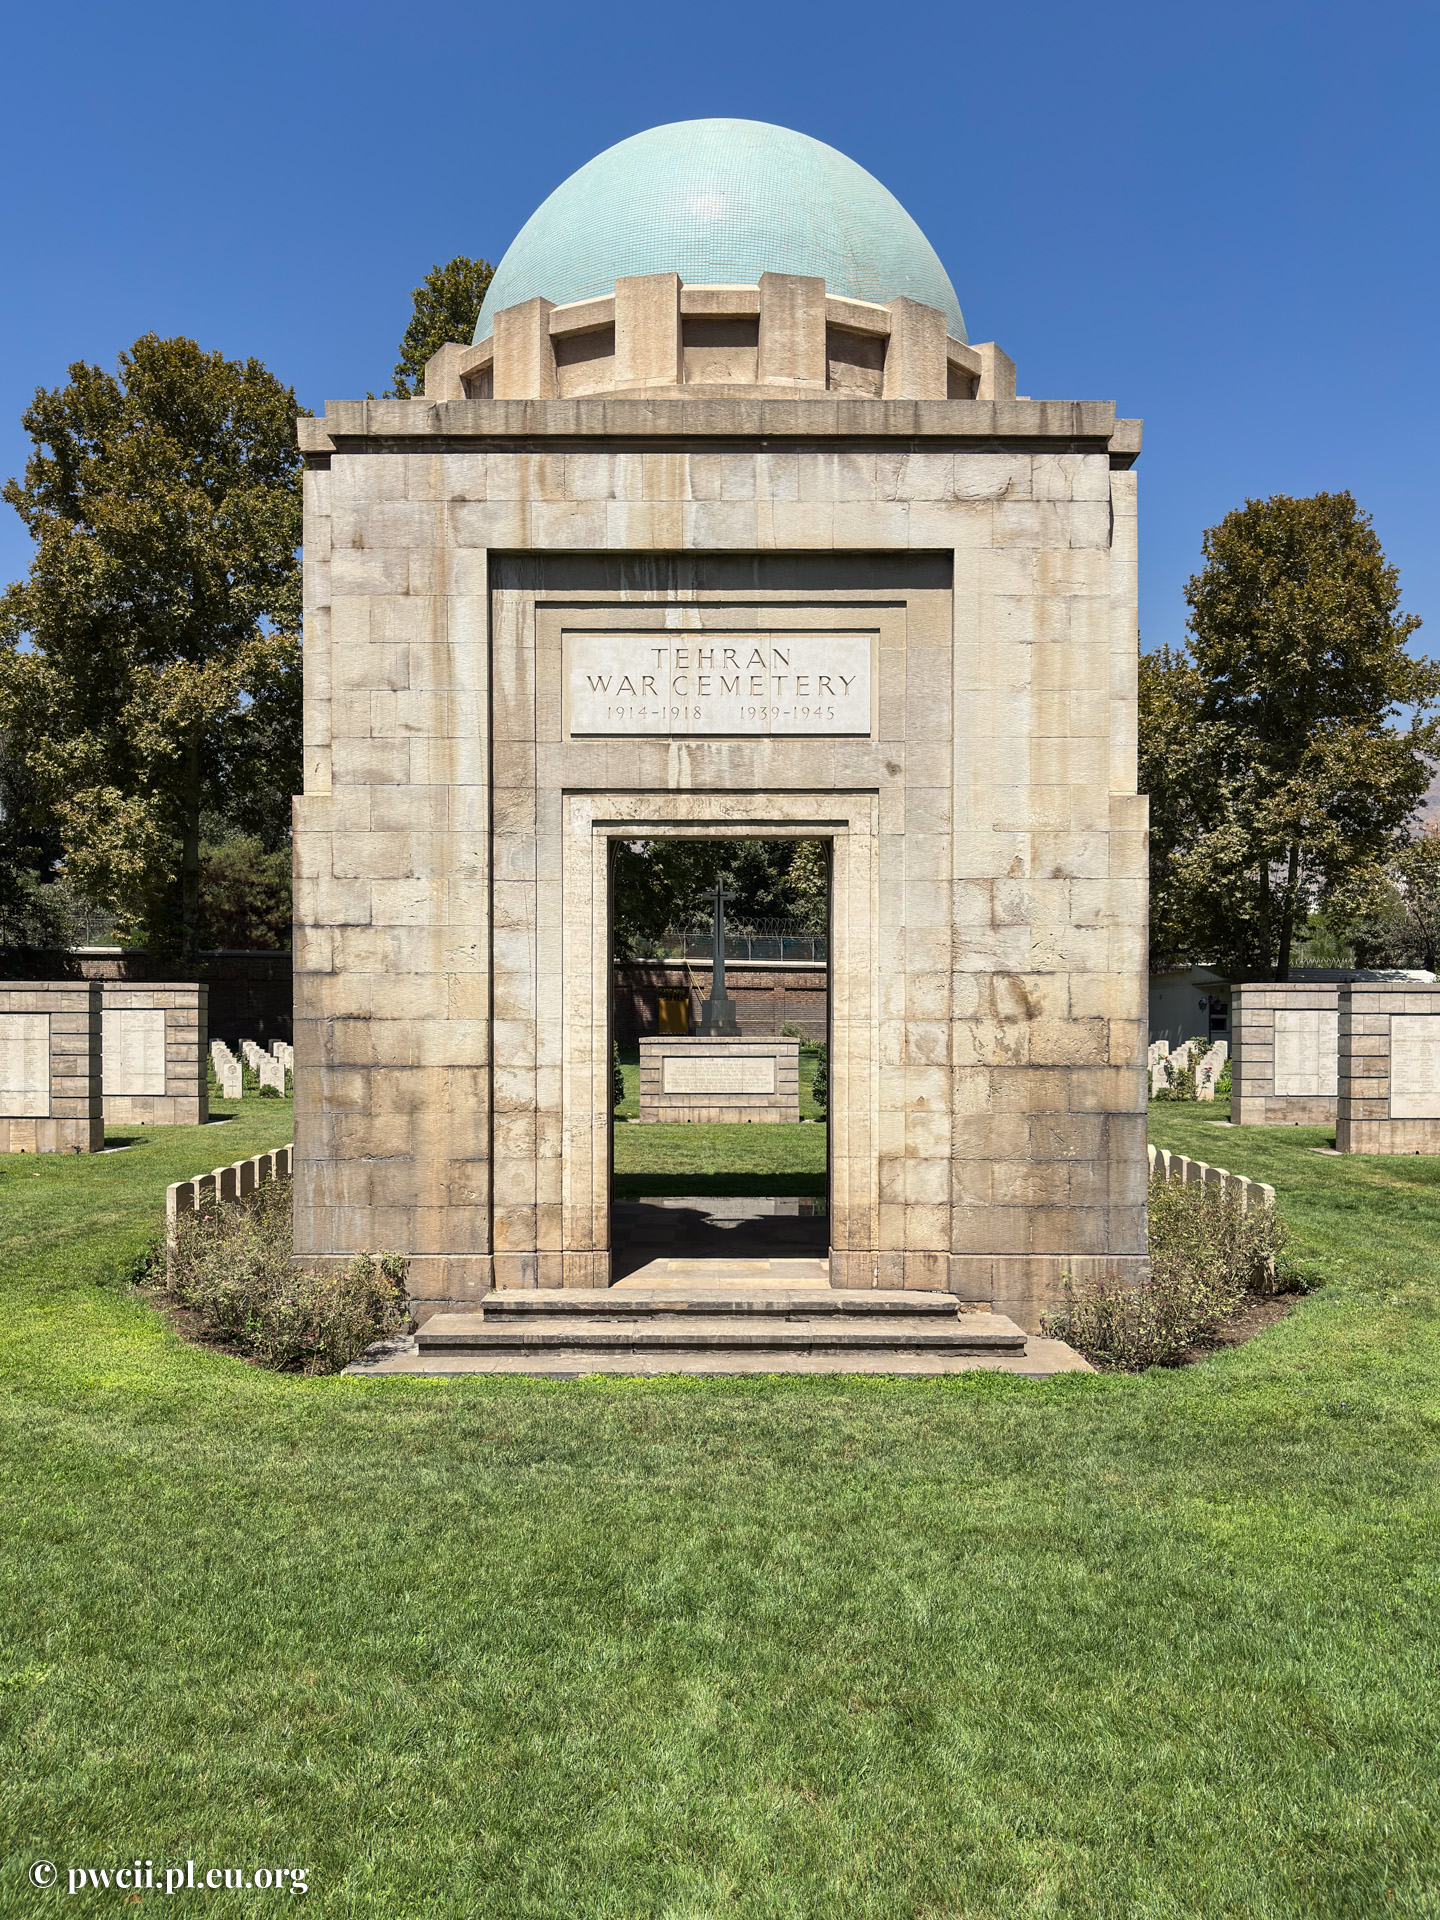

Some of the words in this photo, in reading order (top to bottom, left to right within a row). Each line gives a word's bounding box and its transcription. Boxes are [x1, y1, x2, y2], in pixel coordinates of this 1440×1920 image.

[650, 648, 791, 669] TEHRAN
[586, 675, 659, 697] WAR
[672, 675, 857, 697] CEMETERY
[606, 705, 703, 721] 1914-1918
[739, 705, 835, 721] 1939-1945
